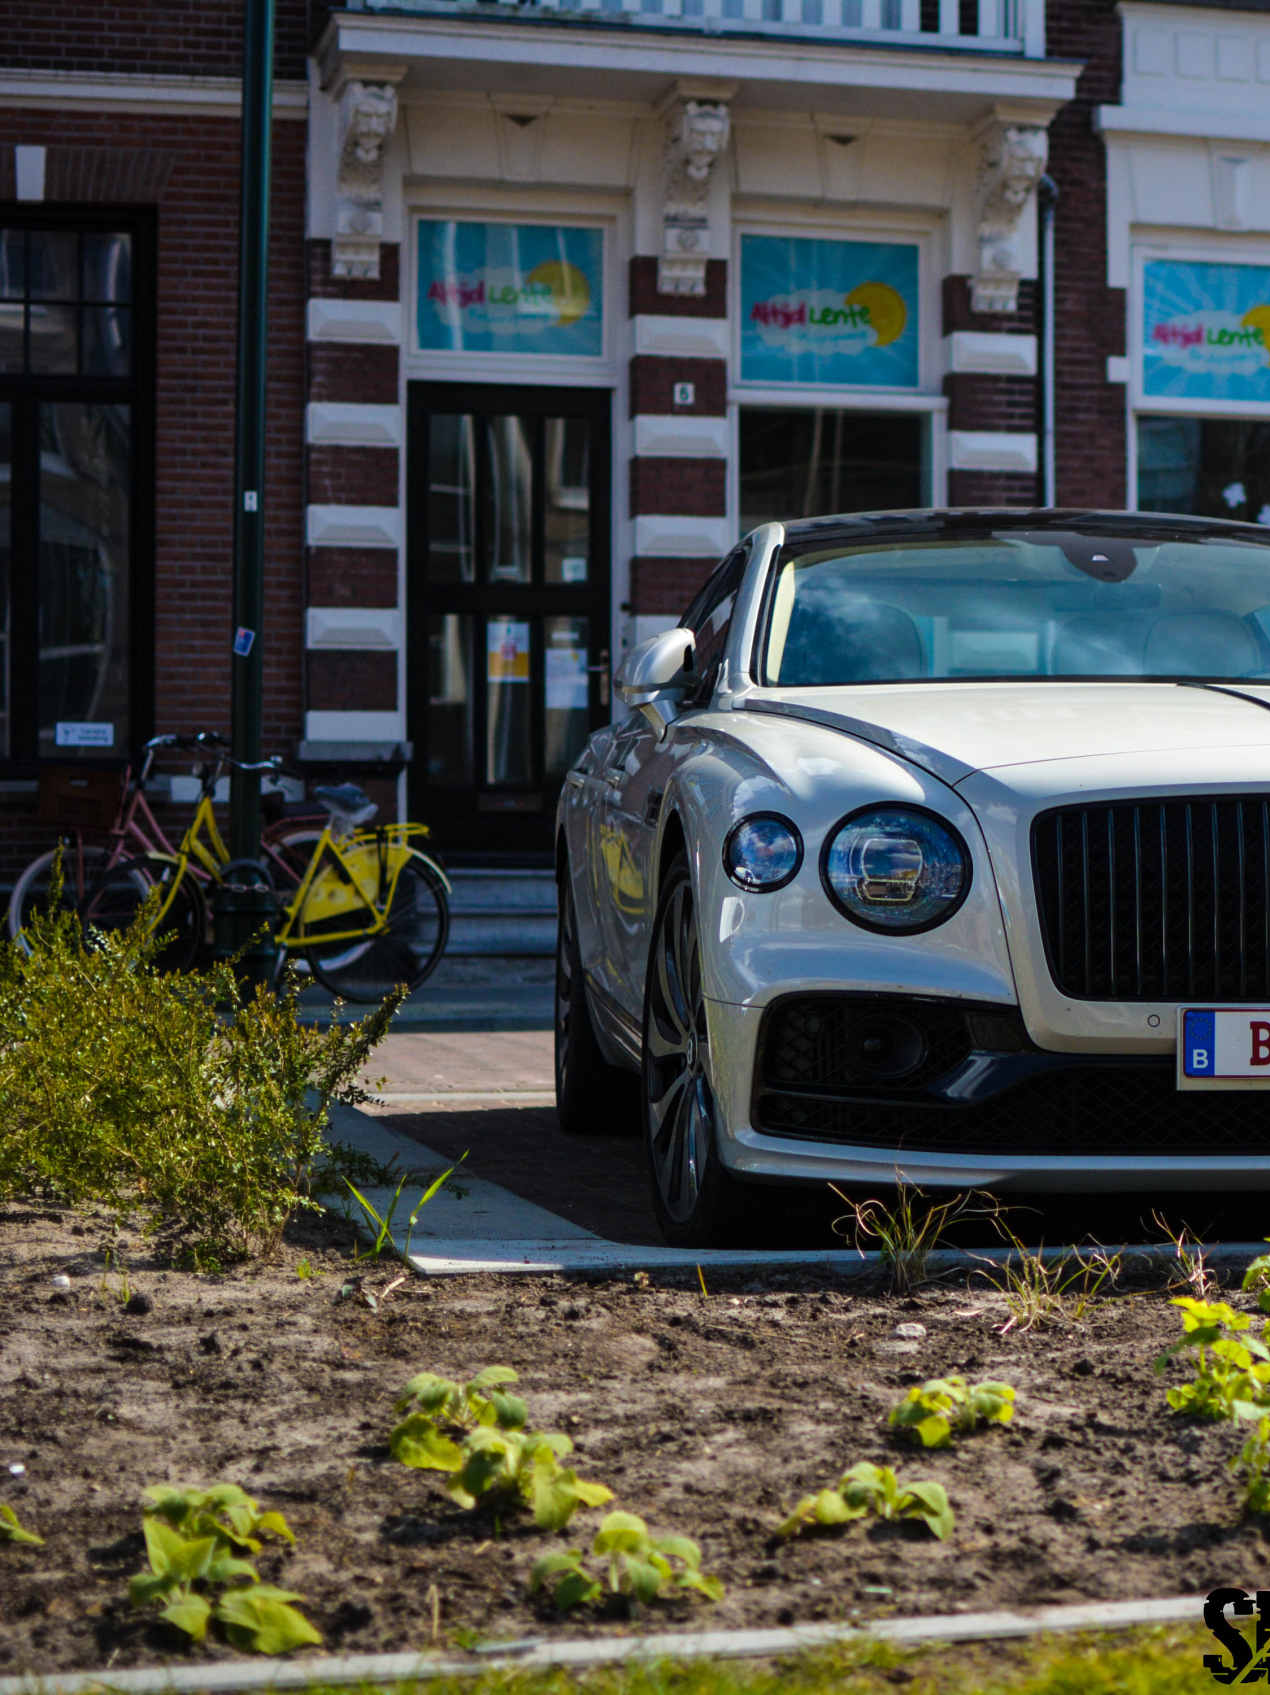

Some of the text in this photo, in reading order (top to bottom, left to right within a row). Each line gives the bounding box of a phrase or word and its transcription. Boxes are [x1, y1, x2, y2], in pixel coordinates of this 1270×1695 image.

[809, 306, 871, 328] Lente
[1207, 327, 1265, 348] Lente
[1192, 1049, 1209, 1069] B
